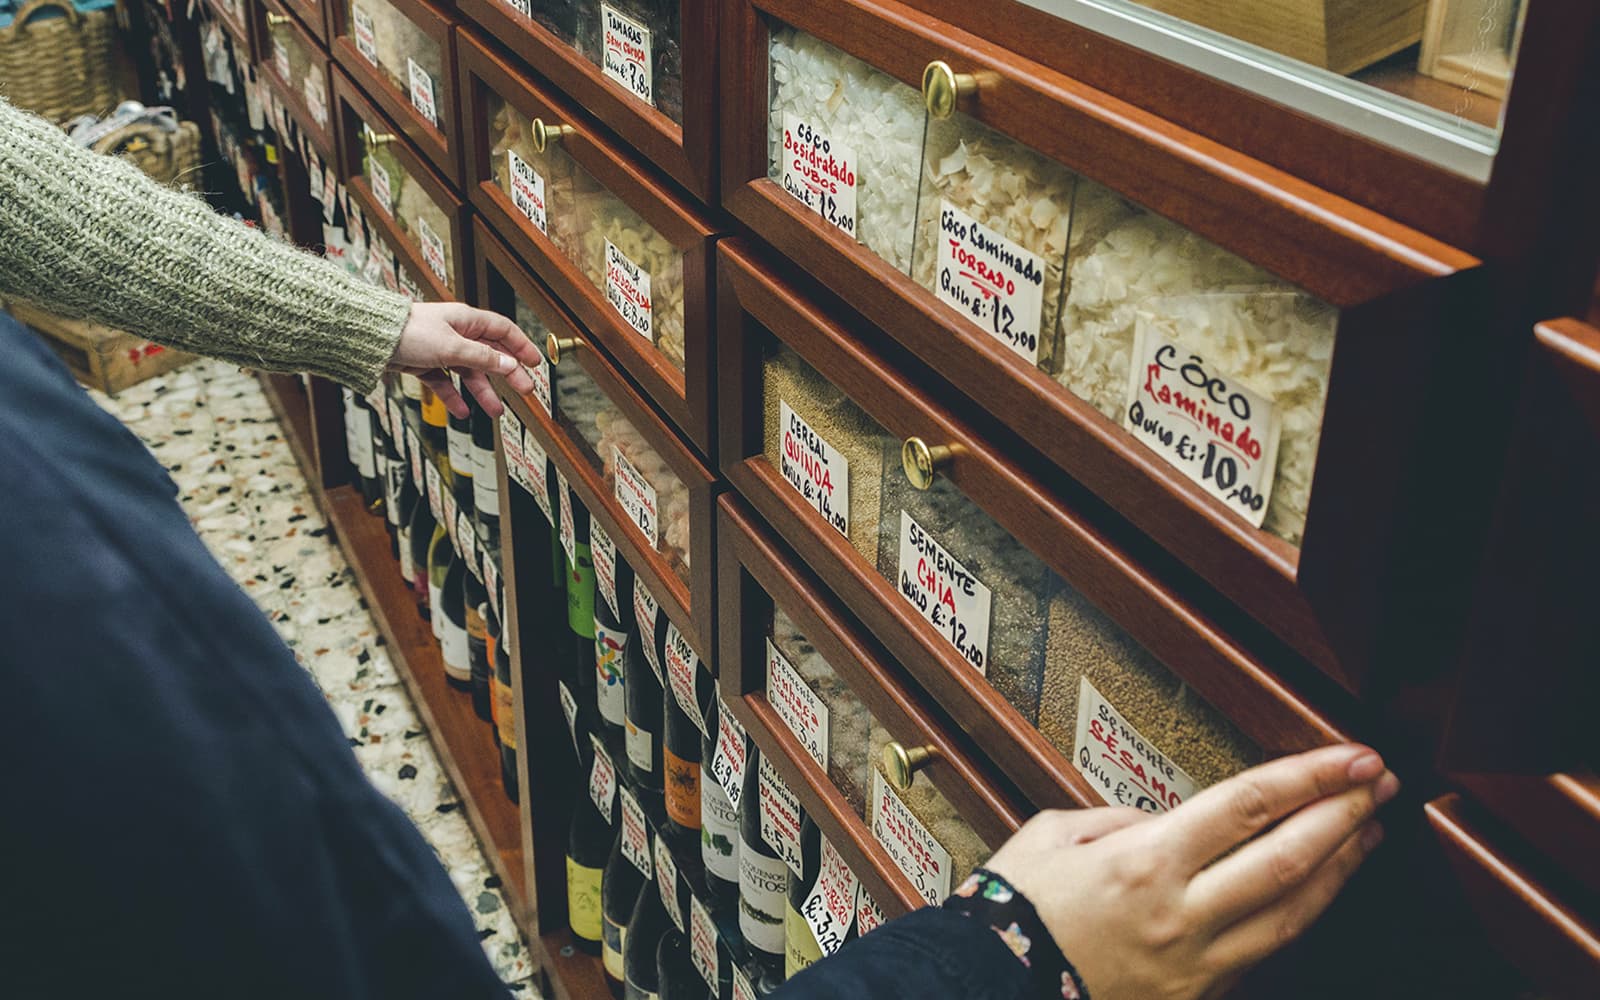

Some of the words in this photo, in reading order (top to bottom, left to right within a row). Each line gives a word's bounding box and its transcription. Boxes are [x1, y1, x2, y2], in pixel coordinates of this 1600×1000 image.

[608, 13, 642, 45] TAMARAS
[784, 130, 855, 187] Desidratado
[793, 159, 837, 194] CUBOS
[949, 239, 1015, 296] TORRADO
[970, 222, 1042, 286] Laminado
[991, 296, 1036, 352] 12,00
[791, 413, 829, 465] CEREAL
[1144, 364, 1261, 460] Laminado
[1200, 442, 1264, 511] 10,00
[910, 523, 975, 596] SEMENTE
[949, 616, 983, 668] 12,00
[1098, 704, 1175, 782] Semente
[882, 795, 939, 874] Linhaça
[915, 865, 937, 907] 3,8
